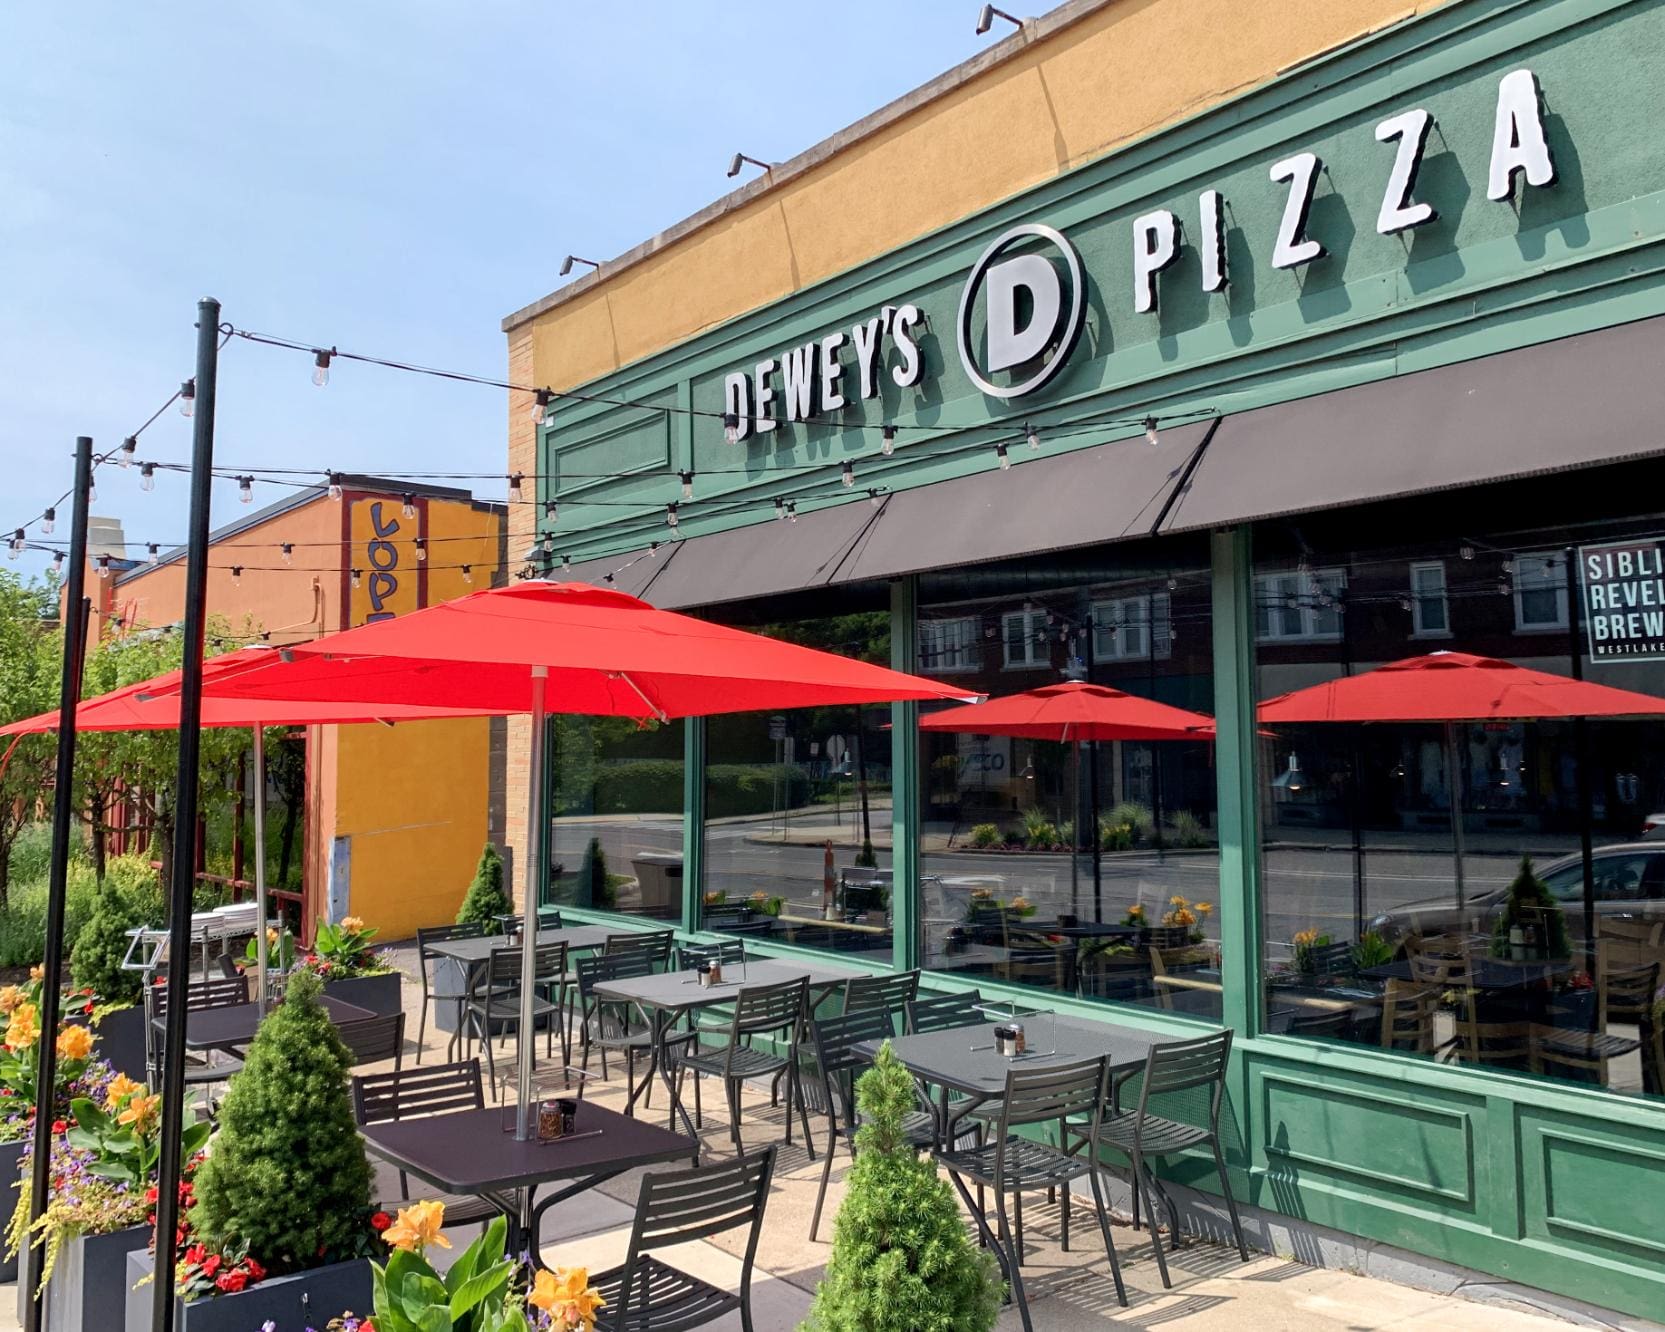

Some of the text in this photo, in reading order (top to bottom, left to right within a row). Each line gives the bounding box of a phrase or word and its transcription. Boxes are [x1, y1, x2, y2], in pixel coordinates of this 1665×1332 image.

[725, 69, 1557, 441] DEWEY'S D PIZZA
[1588, 548, 1663, 580] SIBLI
[1594, 611, 1664, 641] BREW
